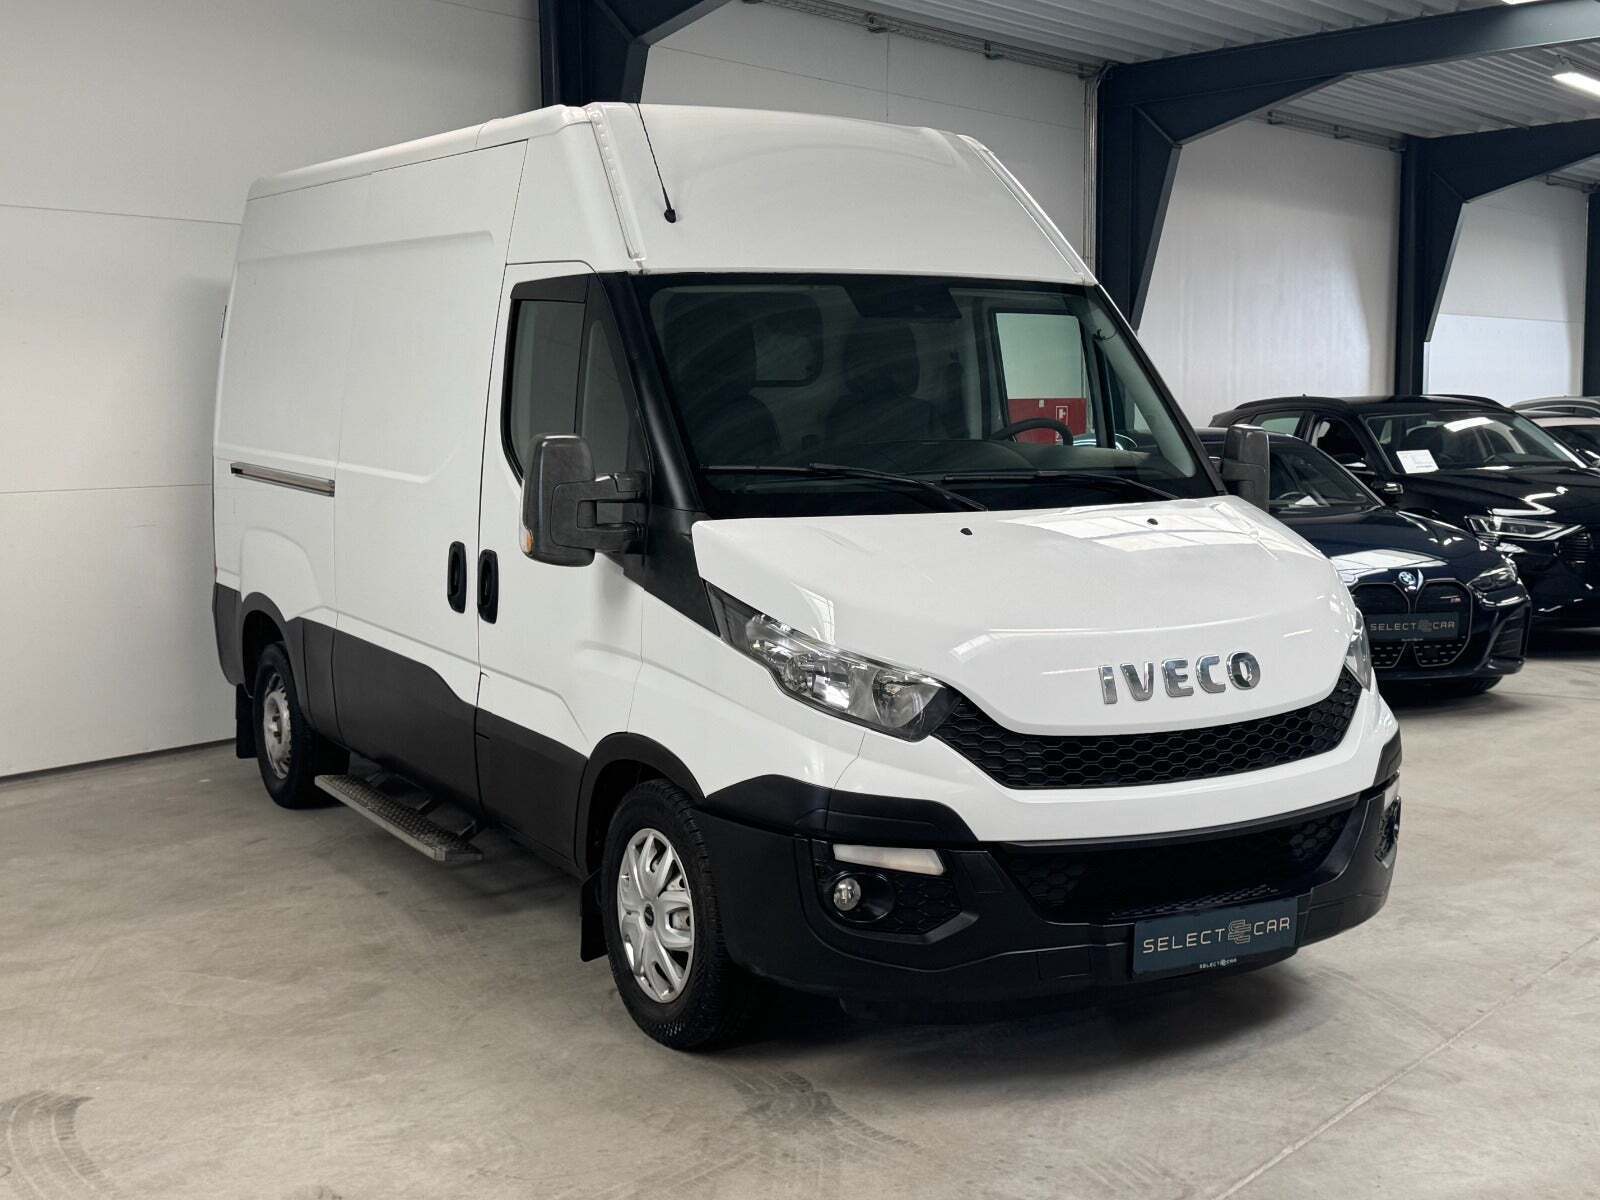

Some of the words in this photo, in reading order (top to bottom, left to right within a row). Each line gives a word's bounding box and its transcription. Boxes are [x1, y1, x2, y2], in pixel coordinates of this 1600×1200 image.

[1370, 622, 1417, 631] SELECT
[1432, 621, 1456, 630] CAR
[1098, 651, 1261, 705] IVECO
[1143, 928, 1226, 954] SELECT
[1253, 916, 1291, 936] CAR
